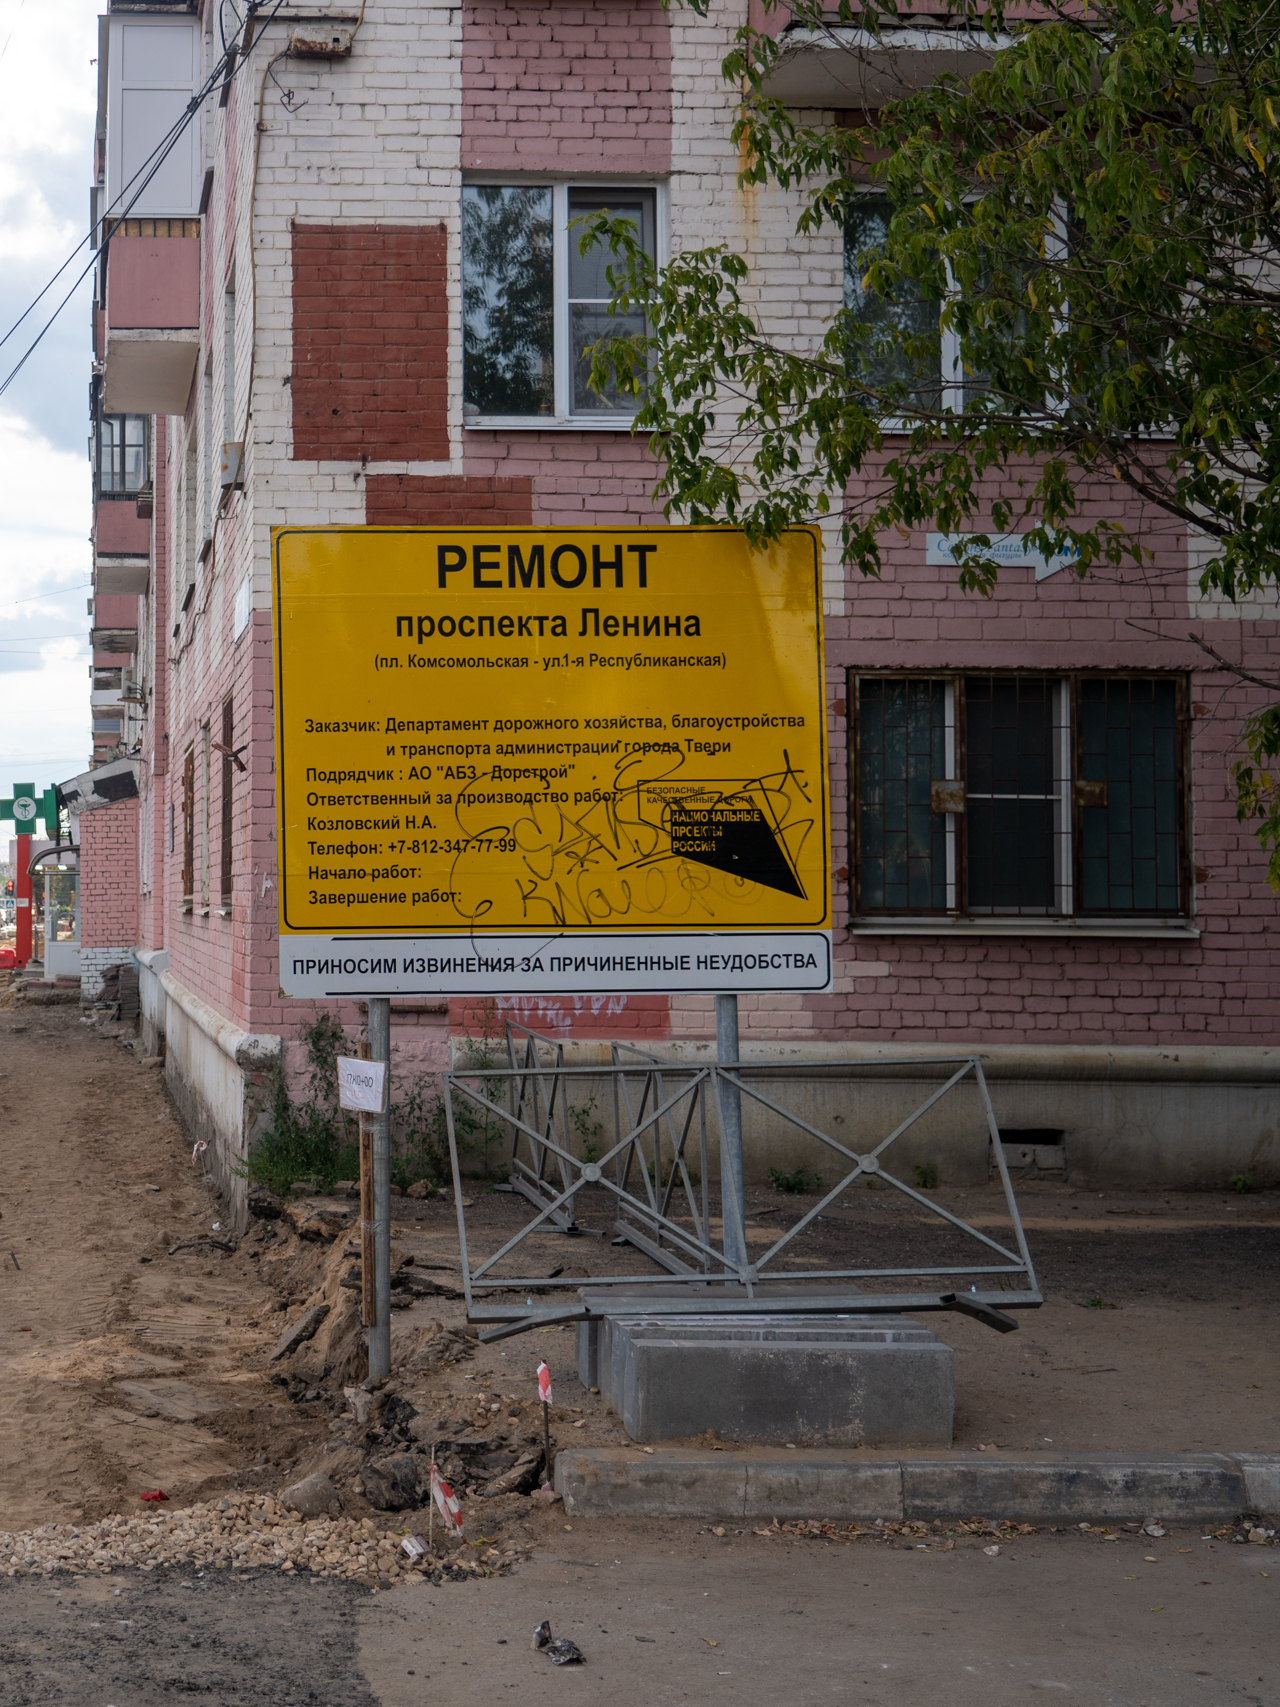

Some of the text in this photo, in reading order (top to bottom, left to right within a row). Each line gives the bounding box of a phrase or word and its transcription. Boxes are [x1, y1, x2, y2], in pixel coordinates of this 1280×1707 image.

[437, 544, 657, 588] РЕМОНТ
[396, 608, 701, 644] проспекта Ленина
[374, 654, 403, 671] (пл.
[408, 654, 529, 668] Комсомольская
[589, 652, 726, 671] Республиканская)
[305, 713, 805, 735] Заказчик: Департамент дорожного хозяйства, благоустройства
[386, 739, 731, 760] и транспорта администрации города Твери
[306, 767, 394, 785] Подрядчик
[408, 766, 432, 780] АО
[491, 764, 576, 782] Дорстрой"
[307, 788, 625, 809] Ответственный за производство работ:
[646, 787, 705, 795] БЕЗОПАСНЫЕ
[646, 796, 714, 804] КАЧЕСТВЕННЫЕ
[307, 815, 437, 831] Козловский Н.А.
[672, 826, 723, 837] ПРОЕКТЫ
[307, 838, 516, 858] Телефон: +7-812-347-77-99
[672, 841, 716, 852] РОССИИ
[308, 864, 421, 883] Начало работ:
[308, 888, 462, 908] Завершение работ:
[293, 953, 818, 975] ПРИНОСИМ ИЗВИНЕНИЯ ЗА ПРИЧИНЕННЫЕ НЕУДОБСТВА
